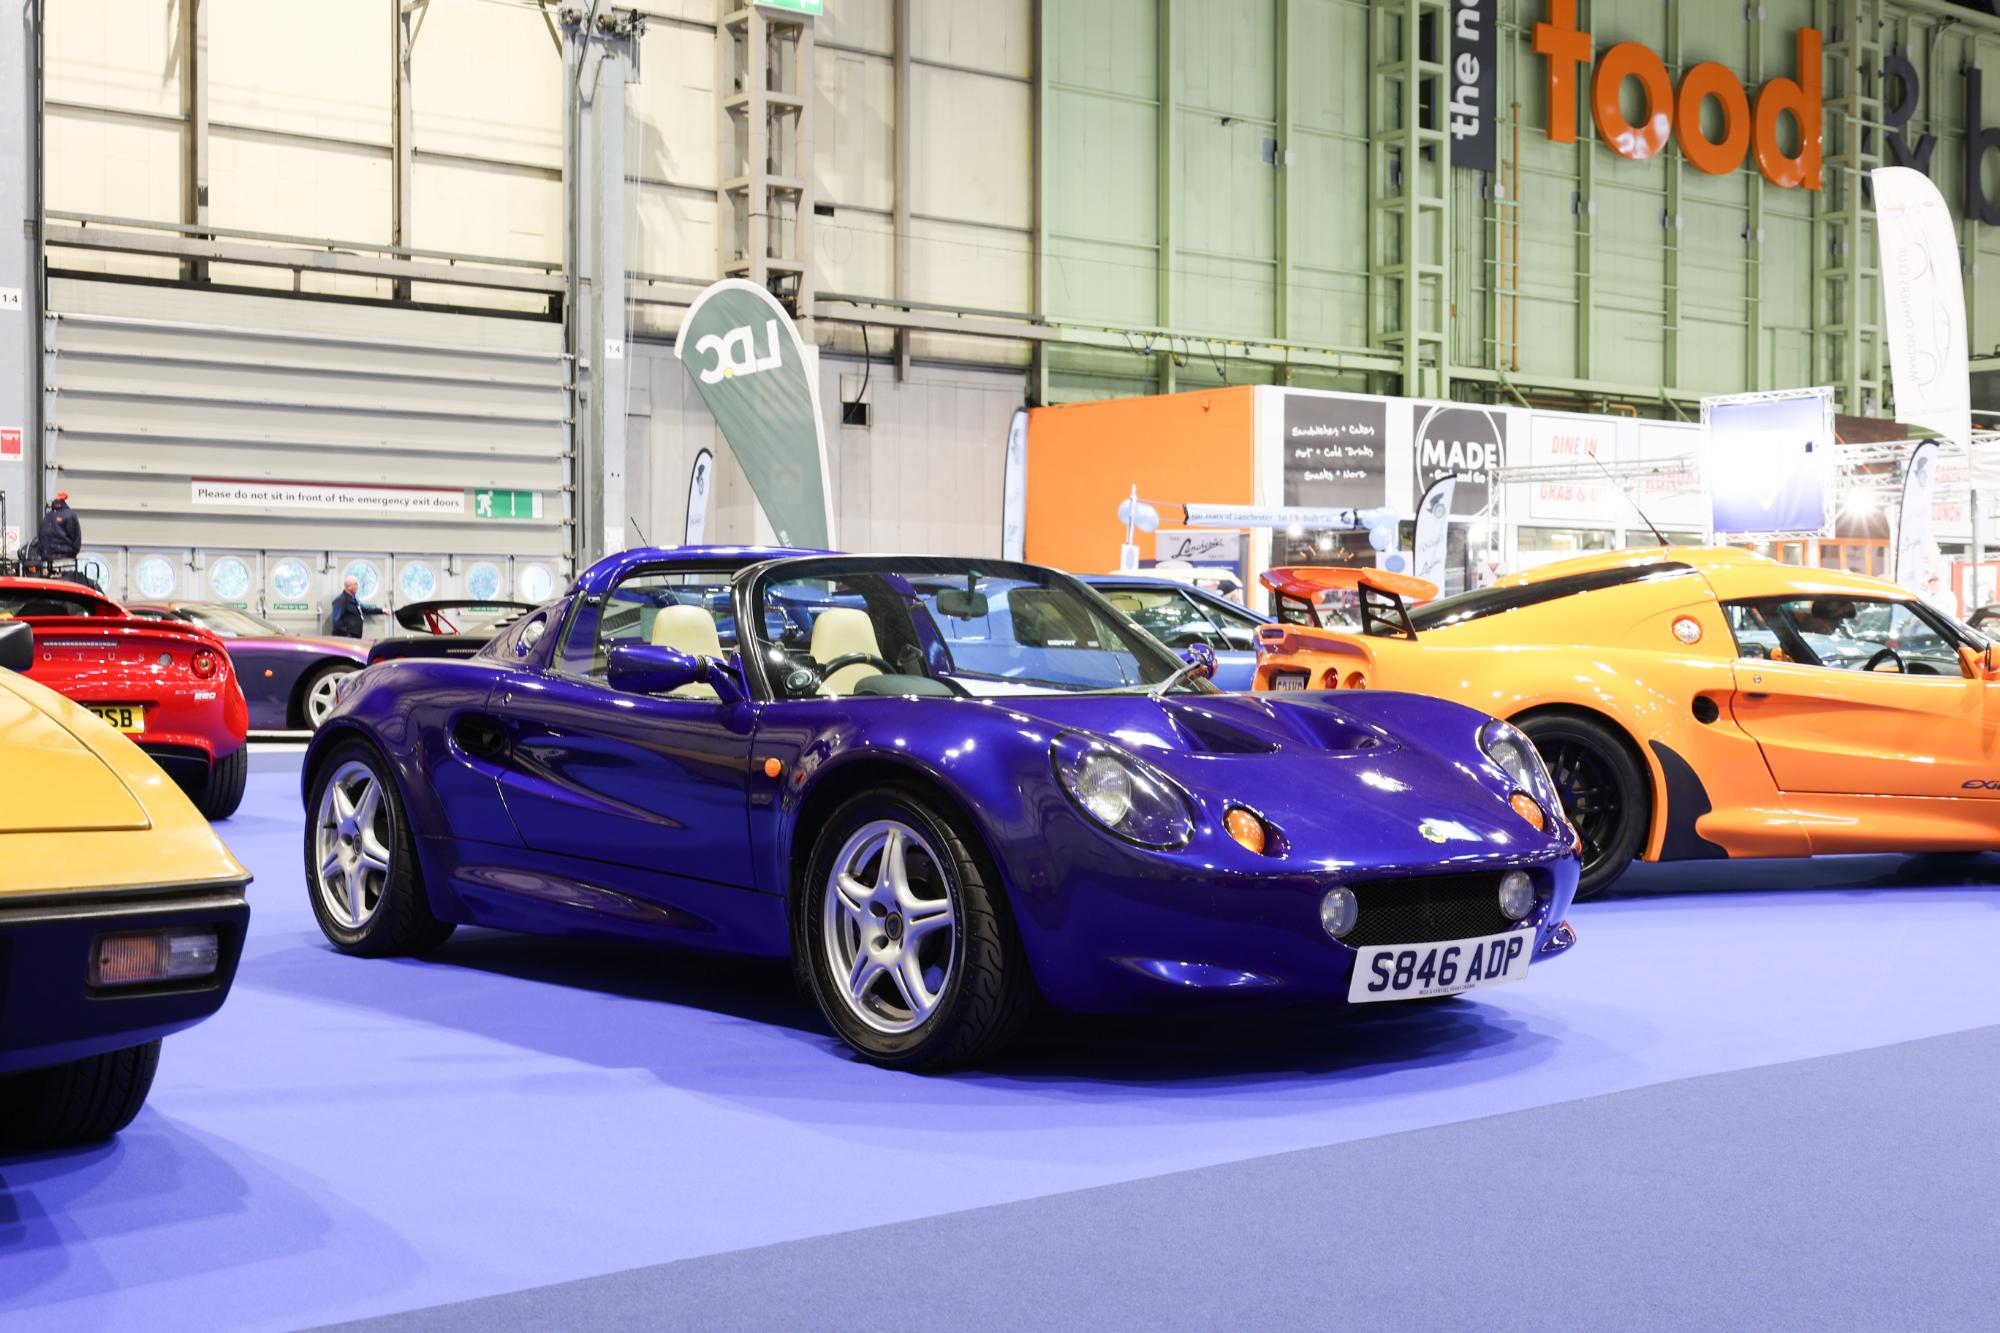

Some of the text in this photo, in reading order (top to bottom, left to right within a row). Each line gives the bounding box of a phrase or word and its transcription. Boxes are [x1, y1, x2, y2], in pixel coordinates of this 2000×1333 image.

[1450, 0, 1480, 141] the n
[3, 293, 18, 303] 1.4
[1348, 423, 1375, 436] Cakes
[1324, 444, 1342, 457] Cold
[1344, 444, 1374, 457] Drinks
[1551, 435, 1598, 456] DINE IN
[1422, 438, 1497, 470] MADE
[1303, 467, 1333, 481] Snacks
[1473, 471, 1486, 484] Go
[198, 488, 459, 508] Please do not sit in front of the emergency exit doors
[43, 652, 145, 662] OTUS
[1368, 936, 1524, 992] S846 ADP
